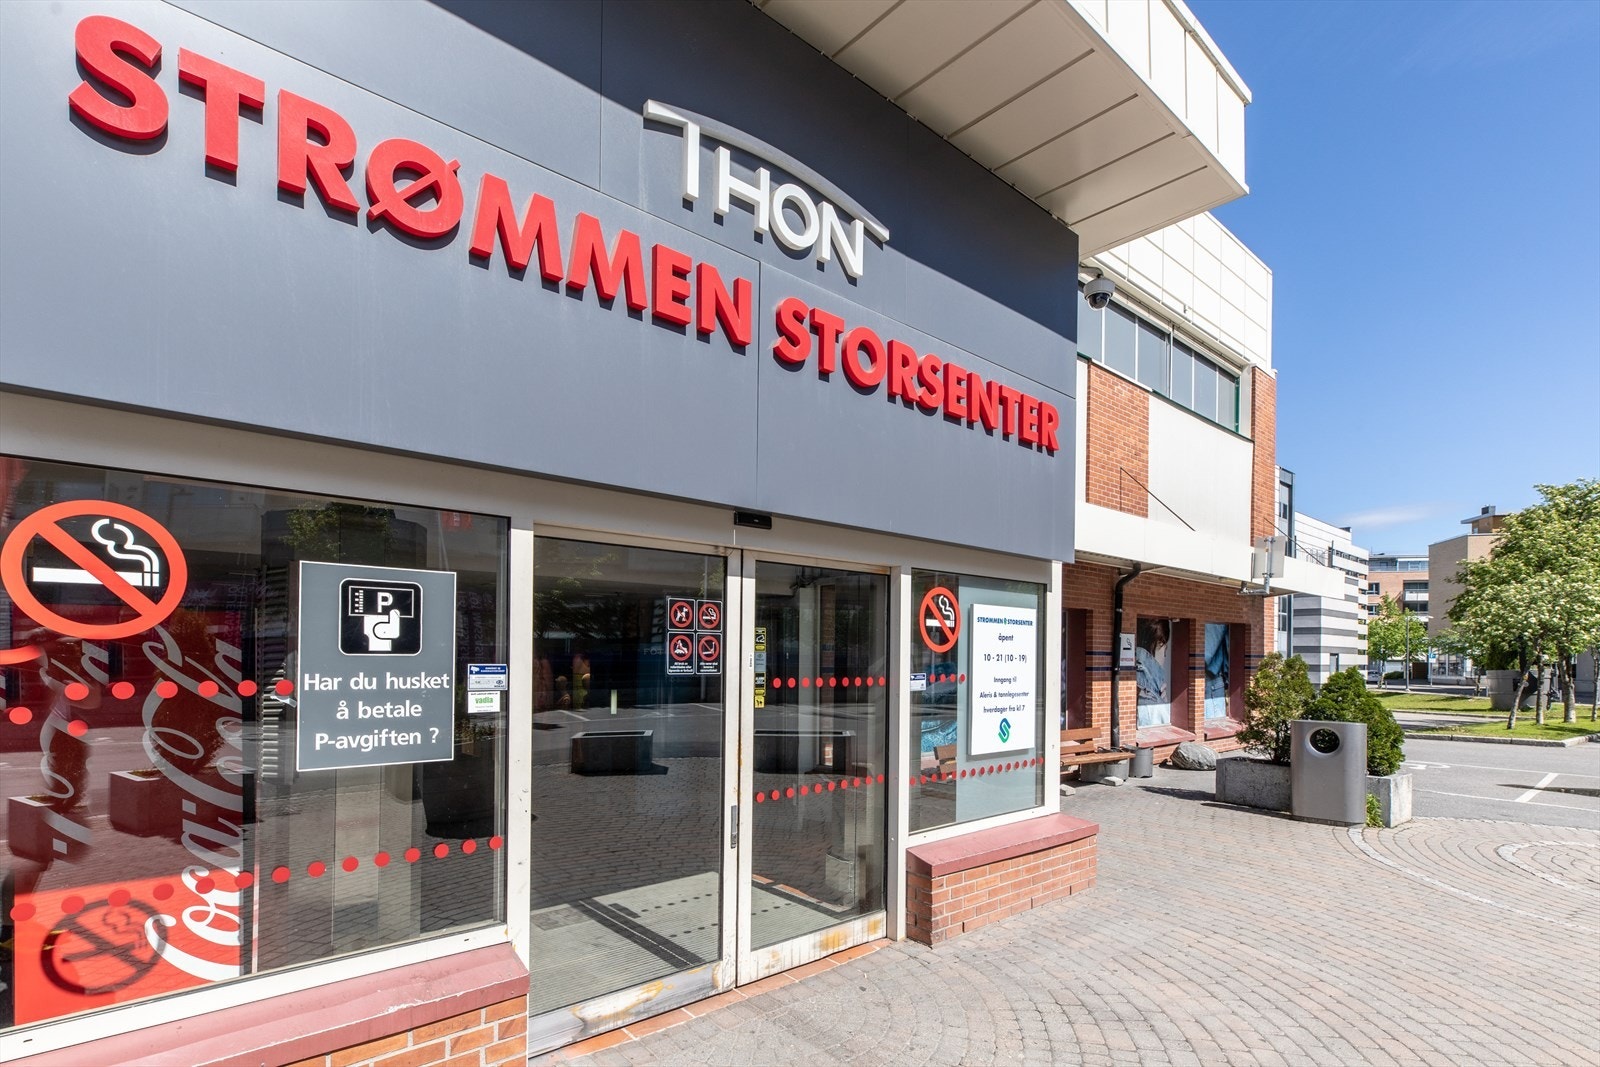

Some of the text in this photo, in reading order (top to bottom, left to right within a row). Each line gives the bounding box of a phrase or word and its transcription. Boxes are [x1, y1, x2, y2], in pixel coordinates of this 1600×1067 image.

[643, 99, 890, 278] THON
[68, 15, 1060, 451] STRØMMEN STORSENTER
[377, 592, 393, 612] P
[998, 633, 1014, 642] åpent
[983, 653, 991, 662] 10
[996, 653, 1003, 662] 21
[1005, 653, 1014, 664] (10
[1018, 654, 1028, 664] 19)
[304, 672, 449, 691] Har du husket
[336, 700, 422, 720] å betale
[315, 727, 439, 752] P-avgiften ?
